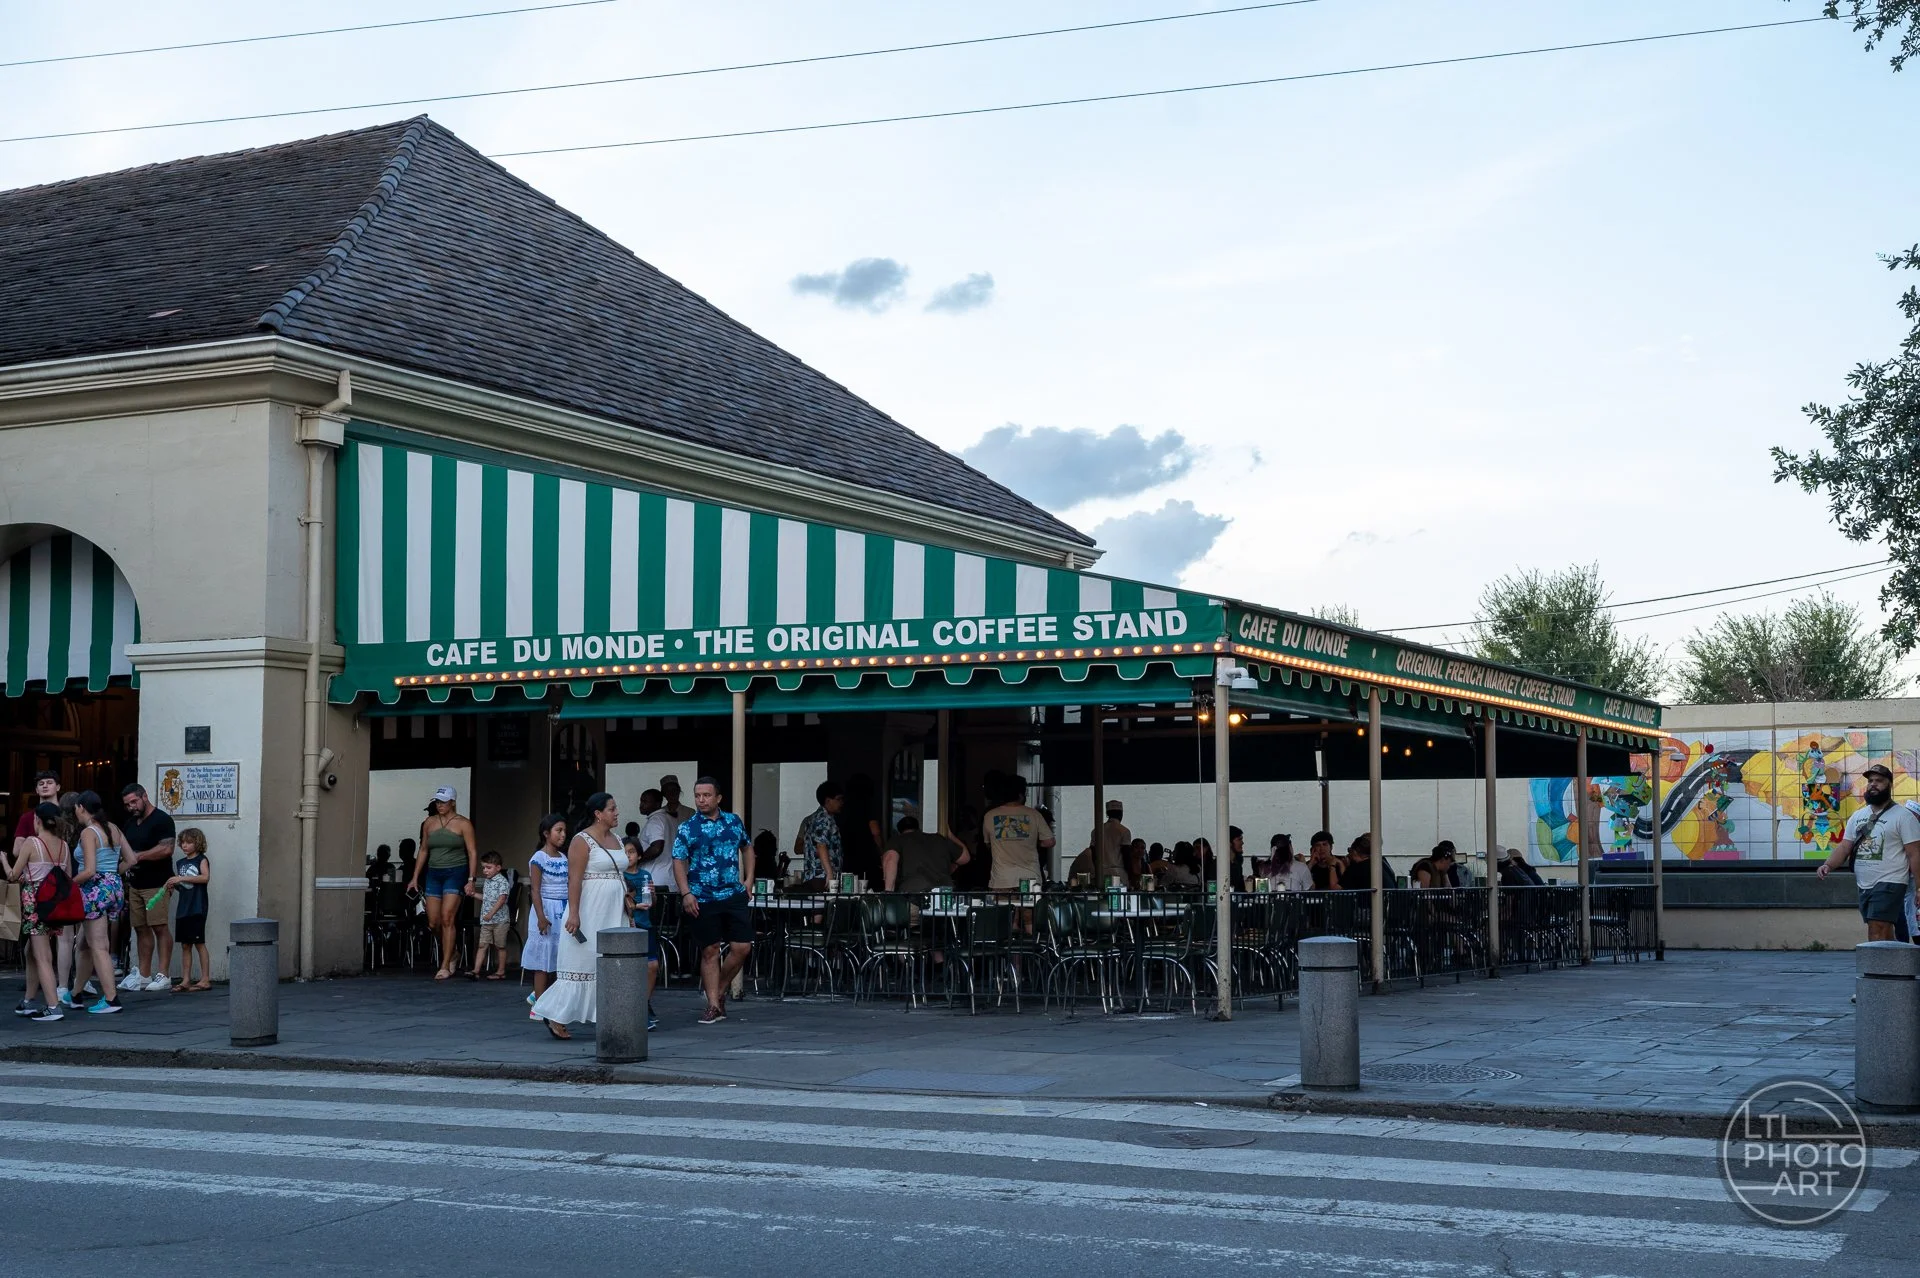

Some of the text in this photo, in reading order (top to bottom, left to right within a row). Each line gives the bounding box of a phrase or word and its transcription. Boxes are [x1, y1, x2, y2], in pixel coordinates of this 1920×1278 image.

[426, 610, 1188, 666] CAFE DU MONDE THE ORIGINAL COFFEE STAND
[1239, 613, 1656, 725] CAFE DU MONDE ORIGINAL FRENCH MARKET COFFEE STAND CAFE DU MONDE
[186, 788, 236, 800] CAMINO REAL
[196, 803, 226, 812] MUELLE
